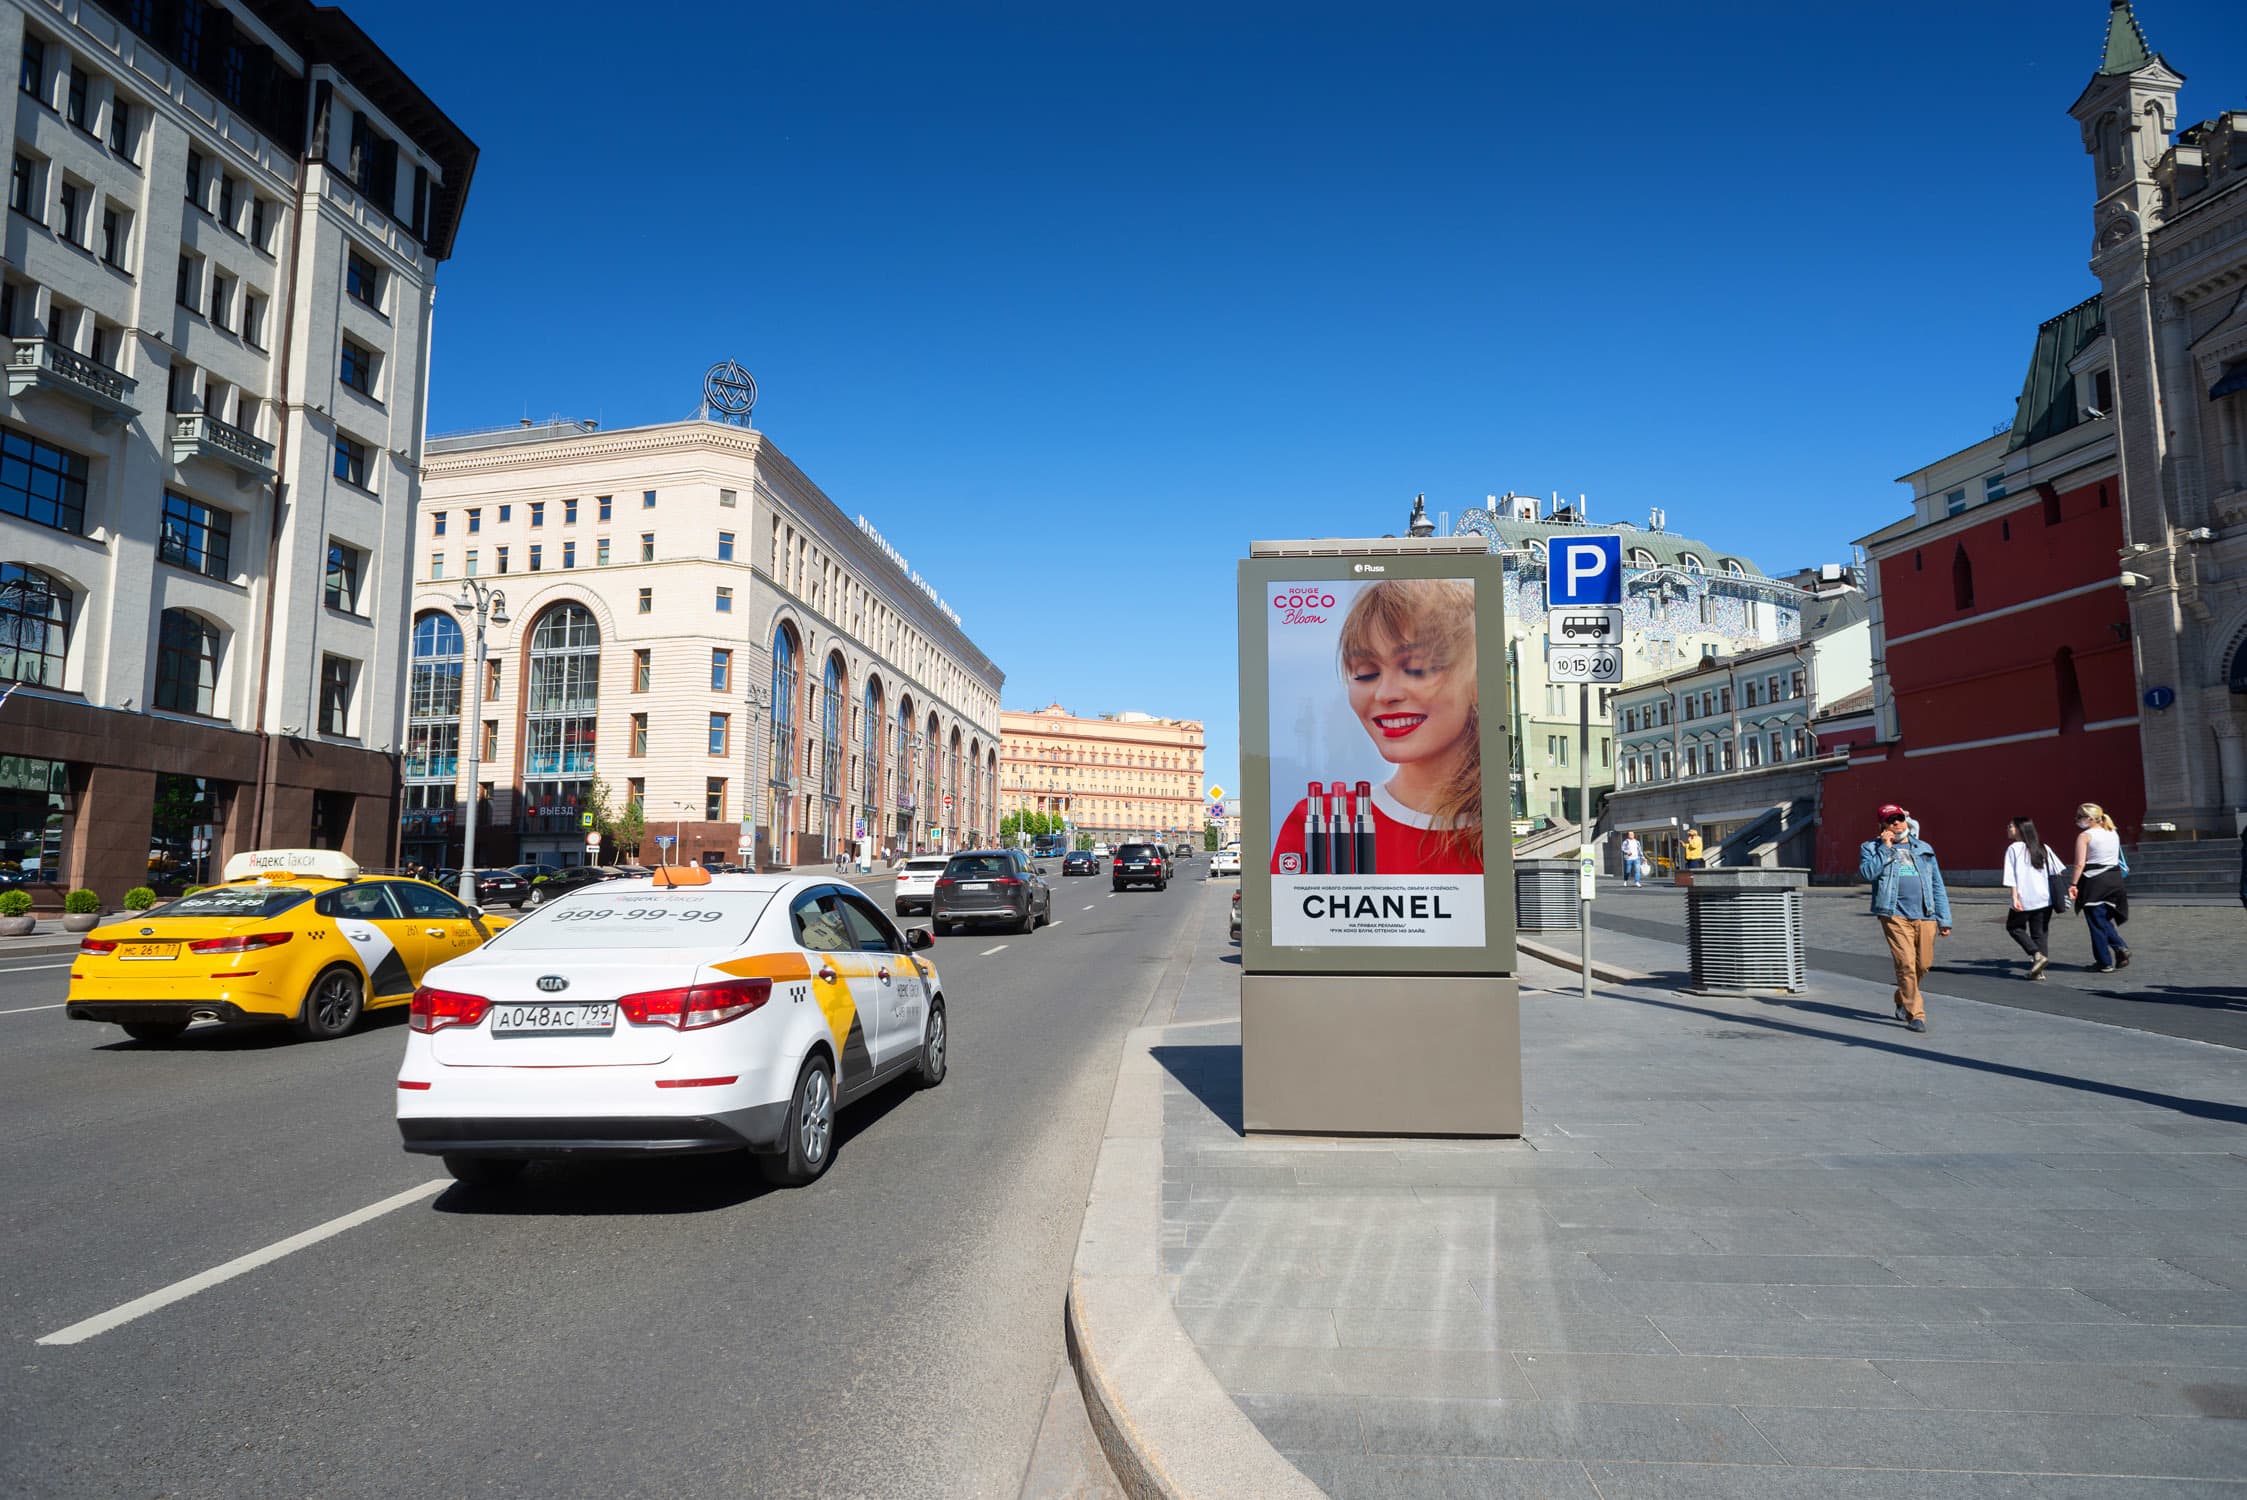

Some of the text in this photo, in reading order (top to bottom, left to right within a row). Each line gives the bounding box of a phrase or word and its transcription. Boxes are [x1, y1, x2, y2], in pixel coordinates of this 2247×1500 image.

[1364, 564, 1385, 573] Russ
[1567, 545, 1606, 597] P
[1273, 594, 1336, 609] COCO
[1281, 608, 1328, 625] Bloom
[1557, 658, 1613, 673] 10 15 20
[2152, 690, 2160, 706] 1
[540, 806, 574, 816] ВЫЕЗД
[249, 852, 316, 868] Яндекс Такси
[1302, 895, 1452, 919] CHANEL
[551, 909, 723, 923] 999-99-99
[539, 978, 564, 990] KIA
[580, 1004, 610, 1020] 799
